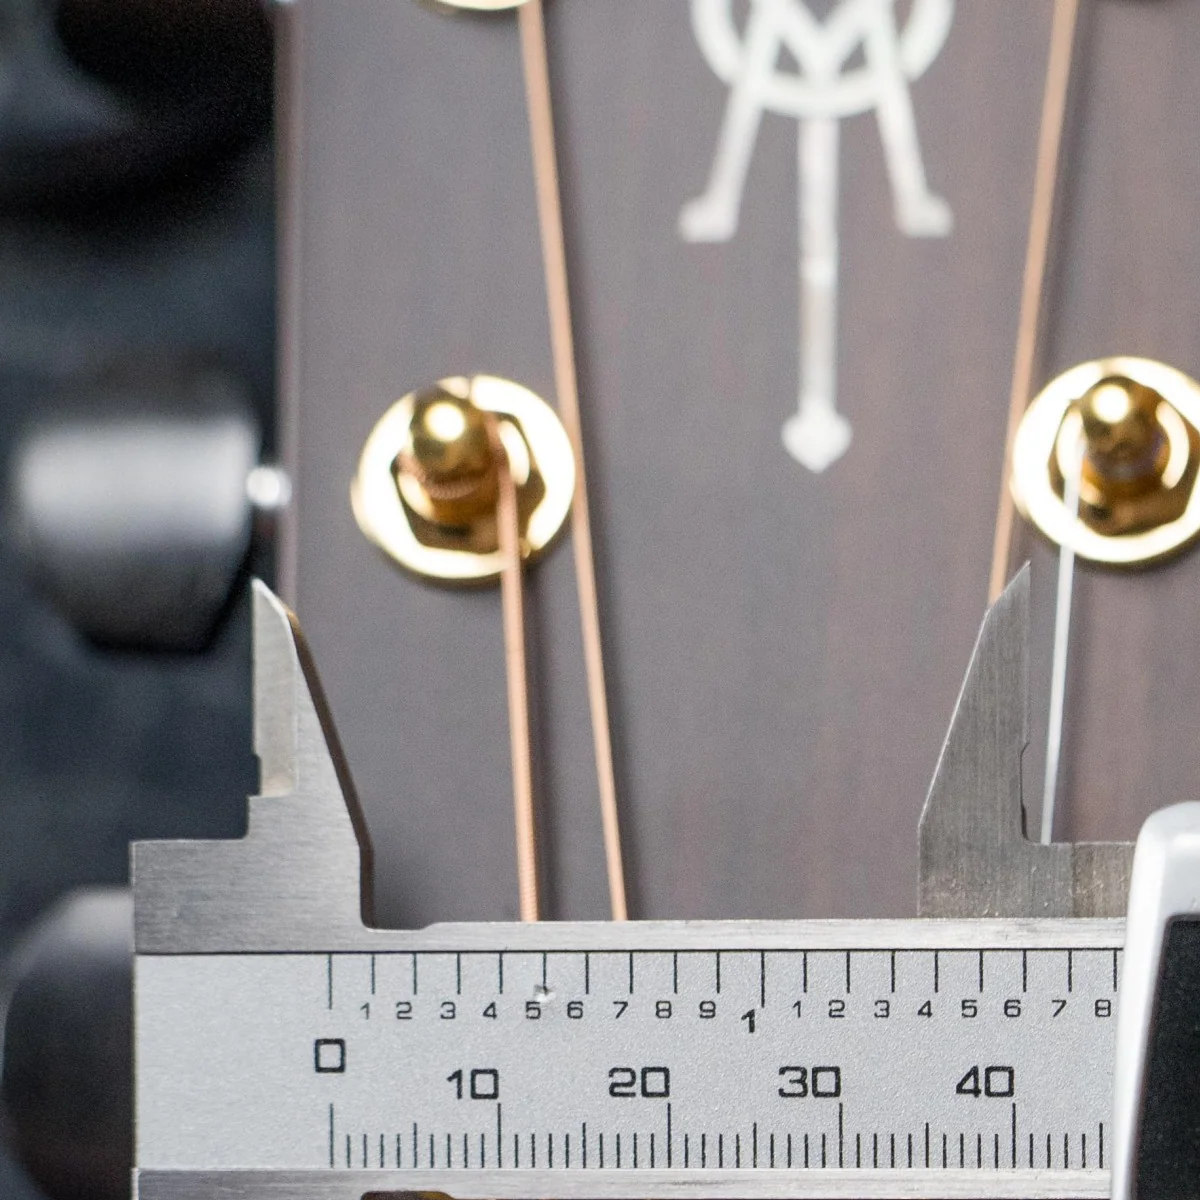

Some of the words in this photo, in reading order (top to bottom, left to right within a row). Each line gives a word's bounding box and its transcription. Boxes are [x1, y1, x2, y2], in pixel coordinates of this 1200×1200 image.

[359, 1001, 370, 1020] 1
[396, 1001, 413, 1020] 2
[440, 1001, 457, 1020] 3
[482, 1001, 498, 1020] 4
[525, 1001, 542, 1020] 5
[566, 1001, 584, 1020] 6
[612, 1000, 629, 1019] 7
[654, 1000, 673, 1019] 8
[698, 1000, 717, 1019] 9
[741, 1009, 756, 1033] 1
[793, 1000, 801, 1018] 1
[828, 1000, 845, 1018] 2
[873, 1000, 891, 1018] 3
[917, 1000, 933, 1018] 4
[961, 1000, 978, 1018] 5
[1004, 1000, 1022, 1018] 6
[1050, 1000, 1067, 1018] 7
[1094, 1000, 1112, 1018] 8
[314, 1038, 346, 1073] 0
[446, 1068, 499, 1100] 10
[608, 1066, 670, 1098] 20
[778, 1066, 842, 1098] 30
[955, 1065, 1015, 1098] 40
